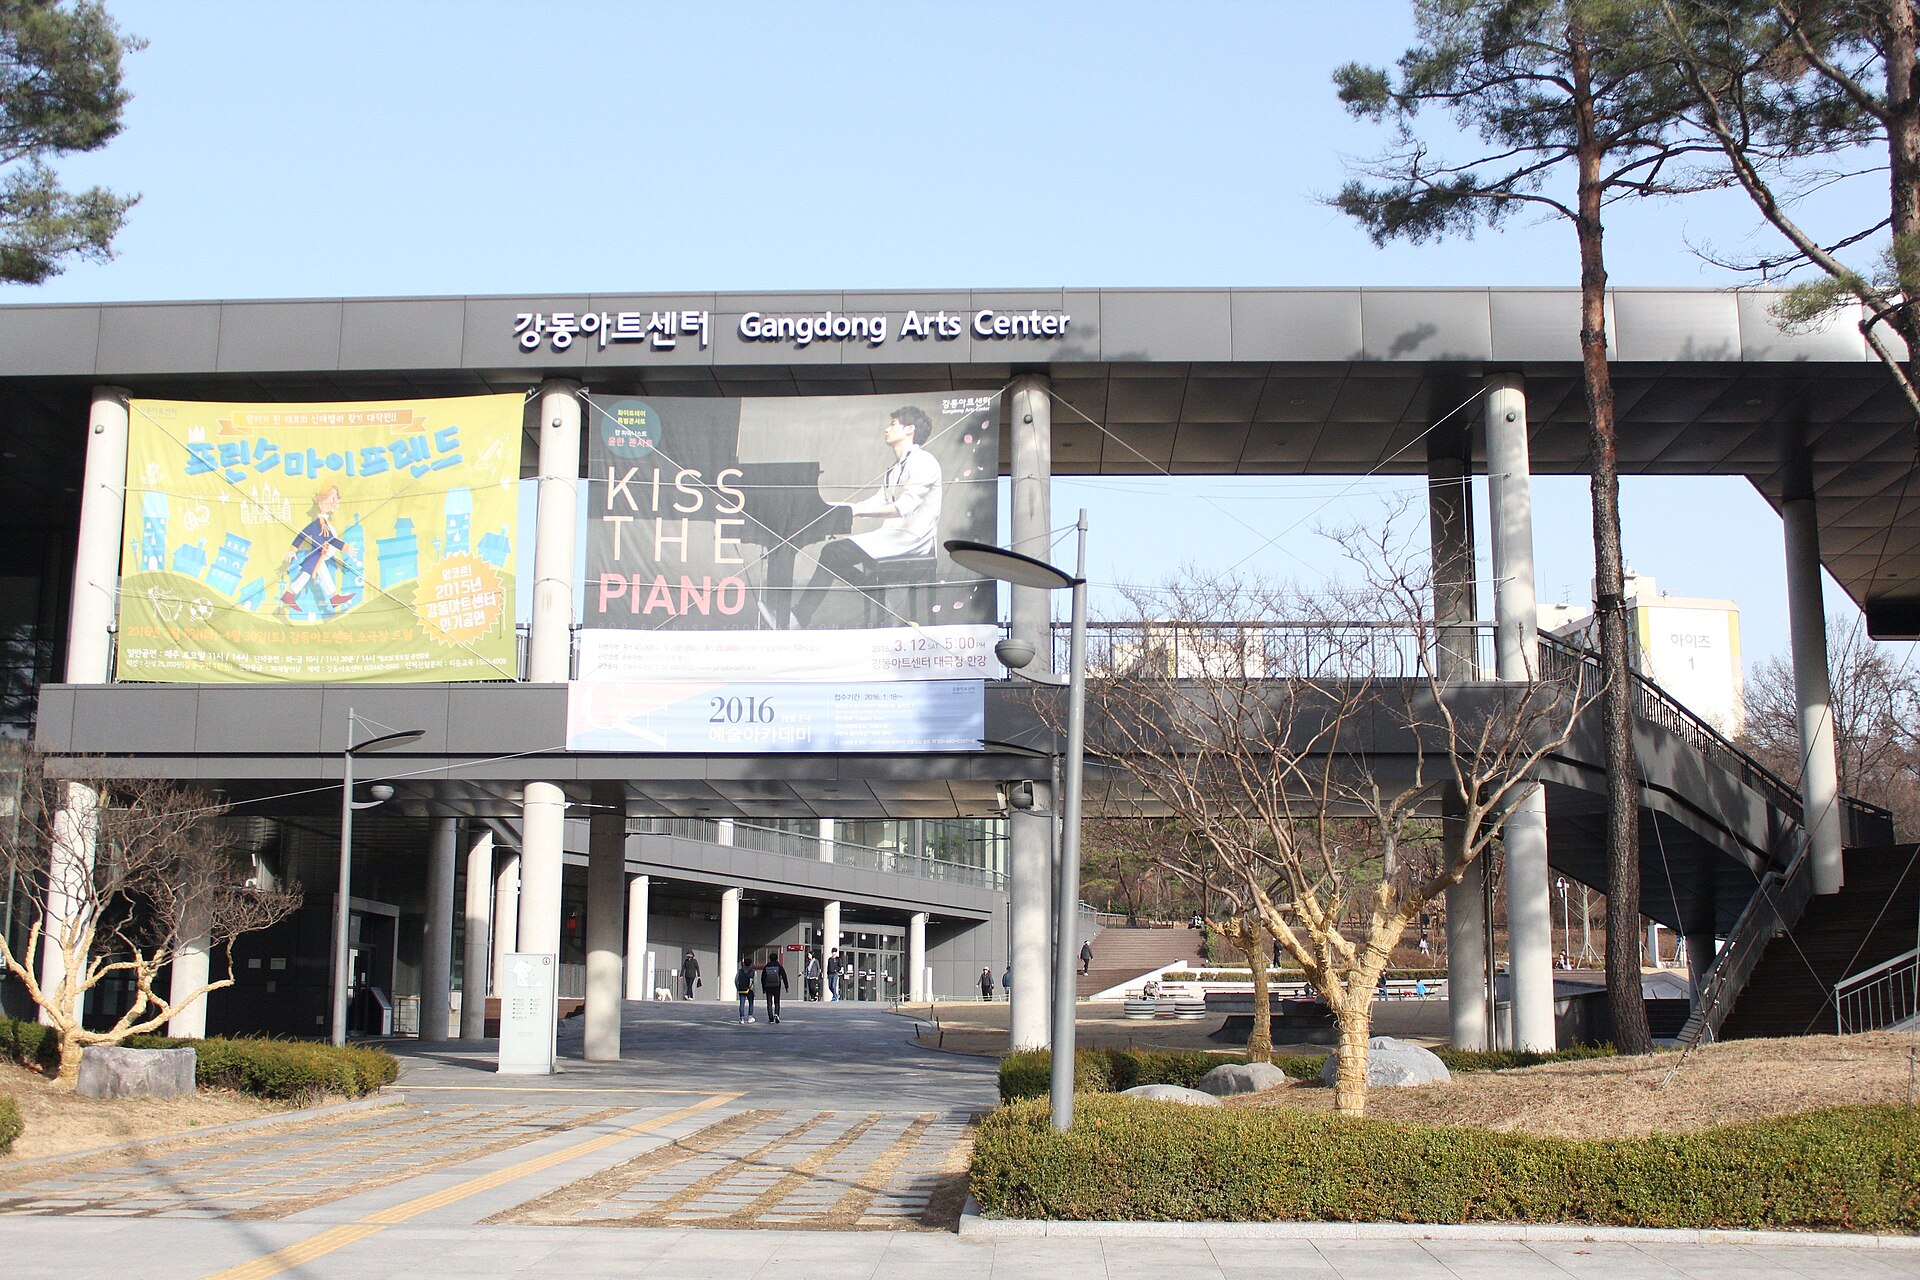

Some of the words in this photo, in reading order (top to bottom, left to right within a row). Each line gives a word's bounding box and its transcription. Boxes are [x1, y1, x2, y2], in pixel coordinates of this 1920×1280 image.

[514, 311, 709, 348] 강동아트센터
[740, 311, 887, 344] Gangdong
[901, 309, 961, 335] Arts
[973, 308, 1070, 335] Center
[942, 396, 991, 409] 강동아트센터
[606, 465, 746, 513] KISS
[602, 515, 746, 564] THE
[435, 576, 482, 599] 2015년
[598, 572, 746, 615] PIANO
[426, 591, 497, 619] 강동아트센터
[439, 610, 486, 632] 인기공연
[289, 630, 354, 645] 강동아트센터
[355, 629, 390, 643] 소극장
[911, 638, 927, 652] 12
[945, 636, 975, 651] 5:00
[1670, 634, 1712, 649] 하이츠
[127, 648, 157, 659] 일반공연
[164, 649, 180, 659] 매주
[181, 650, 206, 661] 토요일
[871, 656, 931, 670] 강동아트센터
[933, 655, 964, 668] 대극장
[966, 655, 988, 668] 한강
[1687, 656, 1695, 671] 1
[834, 693, 861, 702] 접수기간
[709, 695, 775, 724] 2016
[709, 725, 812, 744] 예술아카데미
